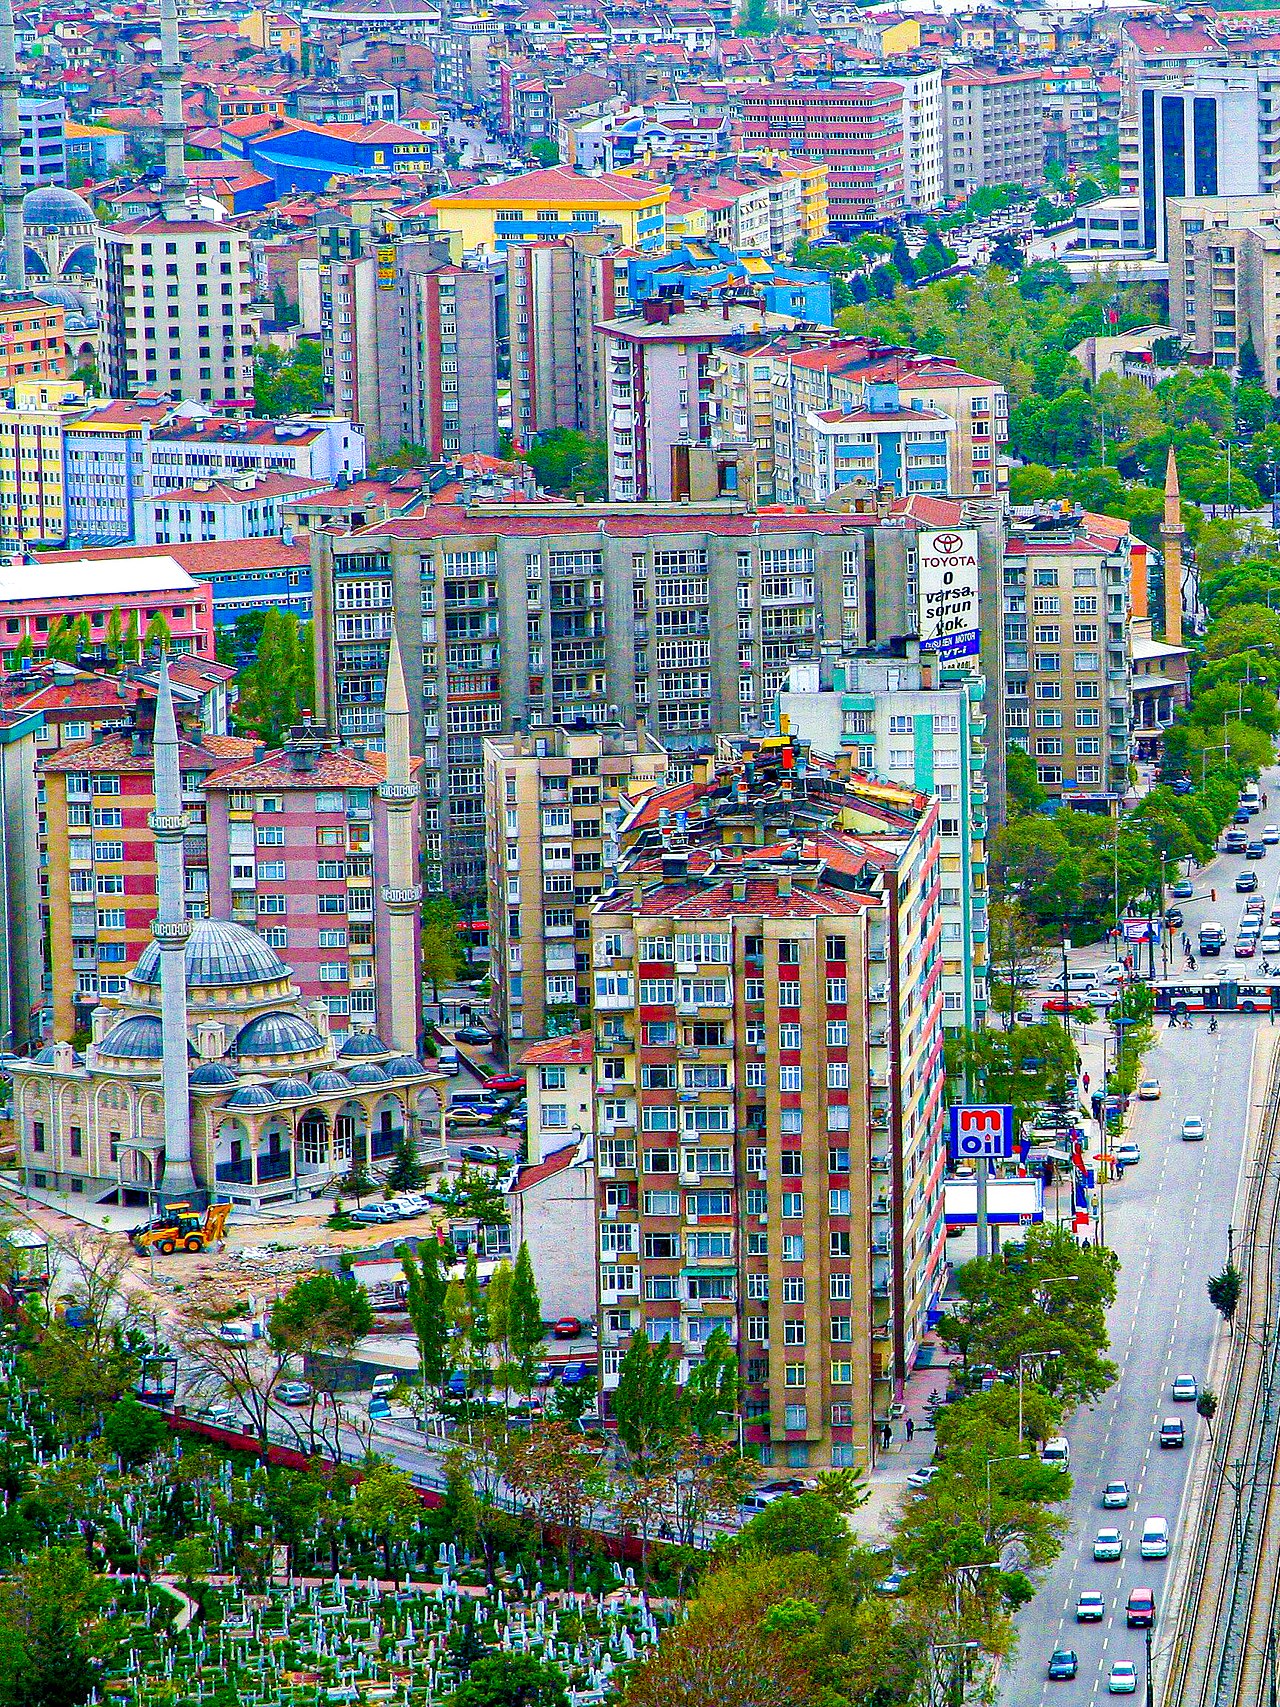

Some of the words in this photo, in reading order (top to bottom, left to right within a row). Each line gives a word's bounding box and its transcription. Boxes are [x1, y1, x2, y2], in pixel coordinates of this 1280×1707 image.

[921, 556, 976, 568] TOYOTA
[926, 585, 975, 604] varsa,
[925, 600, 971, 619] sorun
[935, 616, 968, 636] yok.
[960, 1110, 1001, 1131] m
